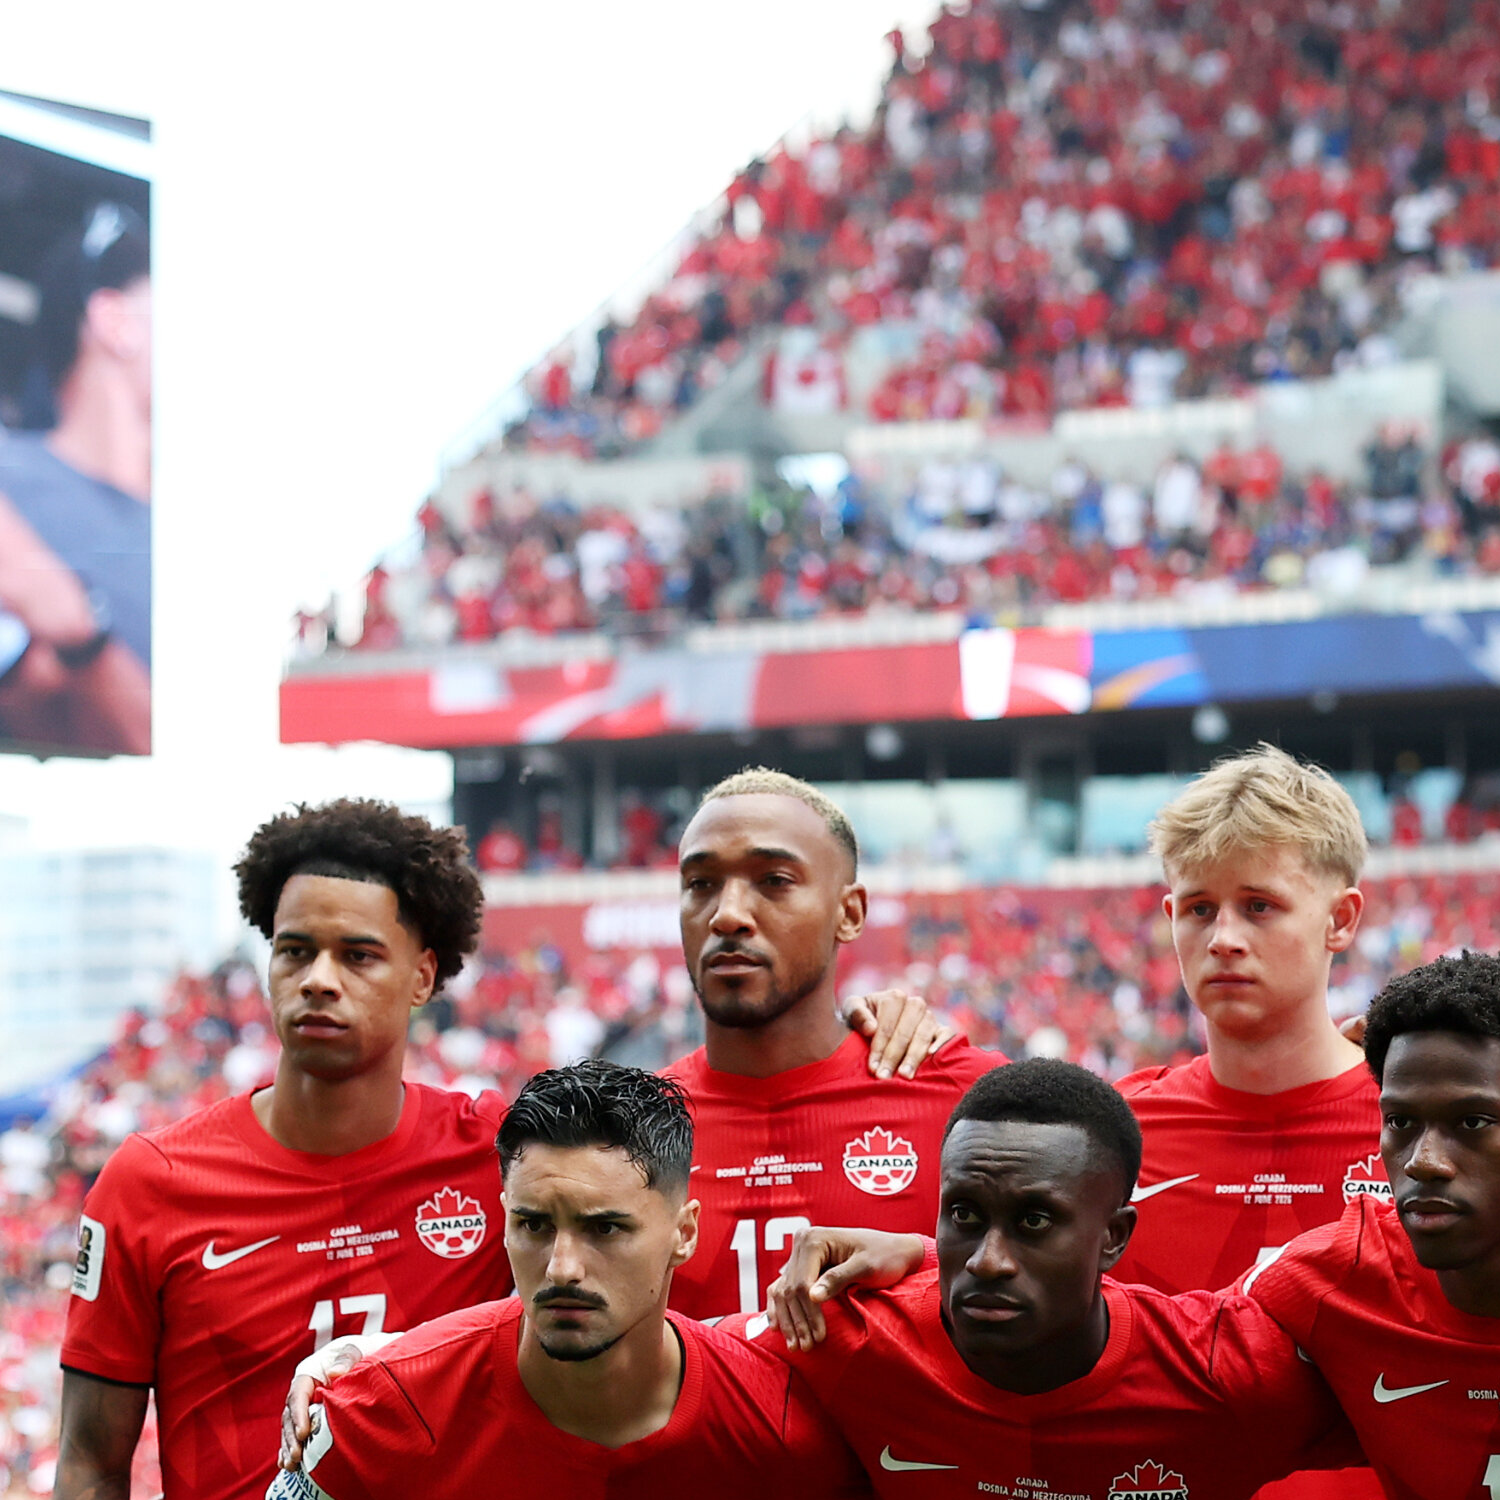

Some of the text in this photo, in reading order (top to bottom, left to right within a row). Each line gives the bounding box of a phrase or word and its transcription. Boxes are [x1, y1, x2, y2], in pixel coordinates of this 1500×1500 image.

[846, 1158, 914, 1168] CANADA
[1345, 1183, 1391, 1194] CANA
[418, 1218, 483, 1233] CANADA
[1468, 1390, 1499, 1399] BOSNIA
[1016, 1477, 1048, 1489] CANADA
[978, 1481, 1008, 1495] BOSNIA
[1012, 1488, 1029, 1498] AND
